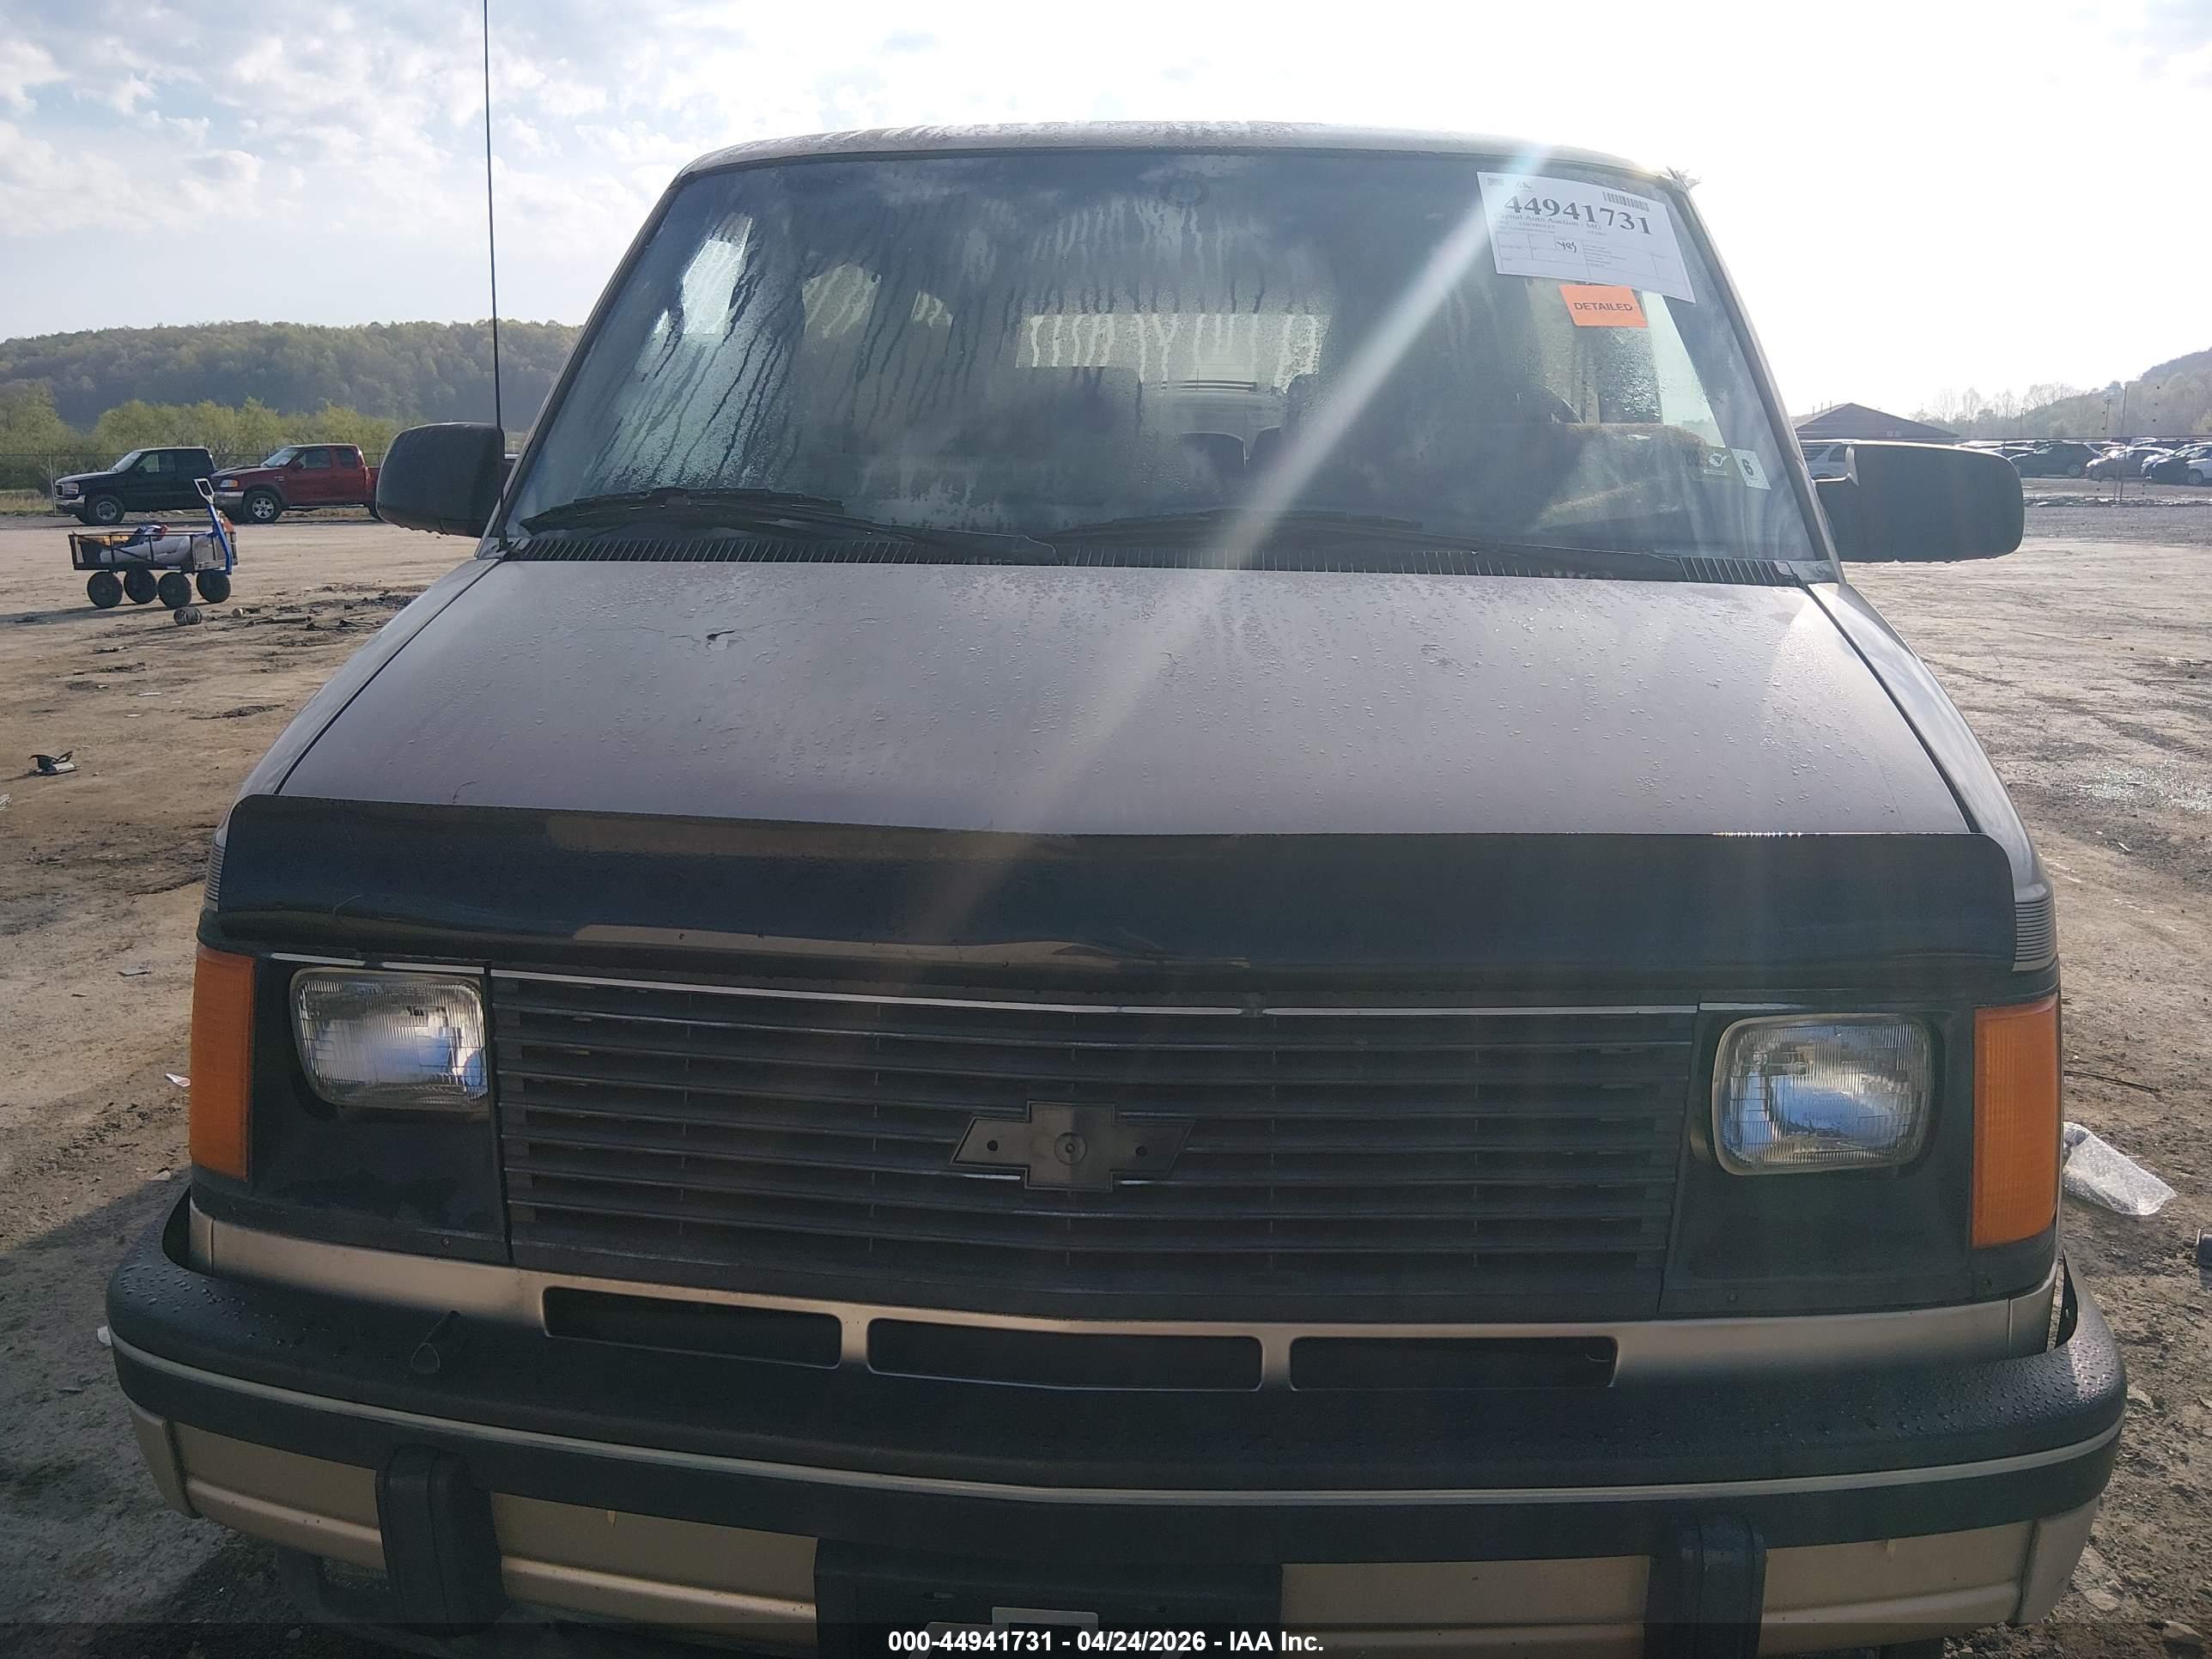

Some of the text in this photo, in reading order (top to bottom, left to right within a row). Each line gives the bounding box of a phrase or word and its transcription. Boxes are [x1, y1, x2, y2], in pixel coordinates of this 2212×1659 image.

[1504, 196, 1653, 235] 44941731
[1547, 217, 1579, 228] Auction
[1573, 301, 1633, 311] DETAILED
[1741, 459, 1754, 476] 6
